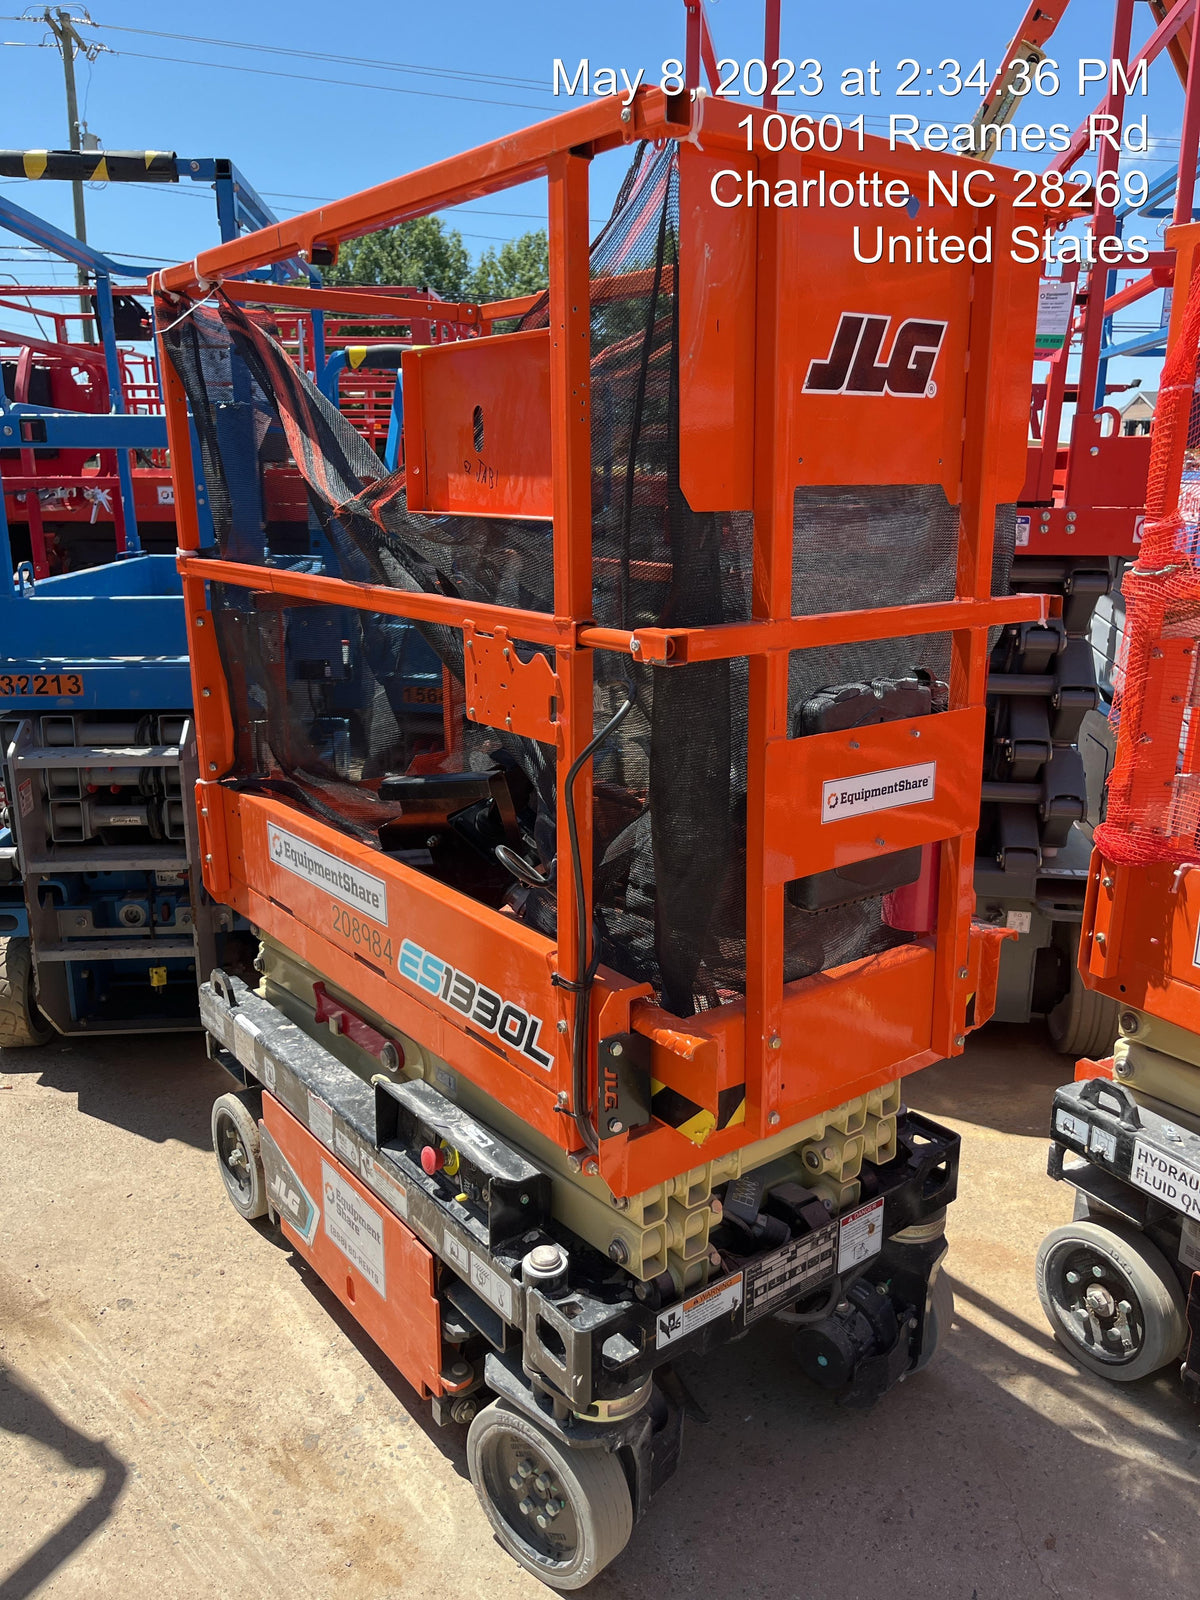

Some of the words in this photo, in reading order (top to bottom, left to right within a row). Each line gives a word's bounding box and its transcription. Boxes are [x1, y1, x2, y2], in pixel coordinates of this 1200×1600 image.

[802, 312, 948, 398] JLG
[839, 777, 930, 805] EquipmentShare
[283, 839, 381, 909] EquipmentShare
[331, 904, 394, 966] 208984
[399, 941, 552, 1070] ES1330L
[604, 1066, 618, 1111] JLG
[270, 1174, 301, 1217] JLG
[1136, 1166, 1177, 1199] FLUID
[335, 1187, 381, 1246] Equipment
[336, 1203, 361, 1237] Share
[854, 1202, 878, 1219] DANGER
[699, 1279, 734, 1302] WARNING
